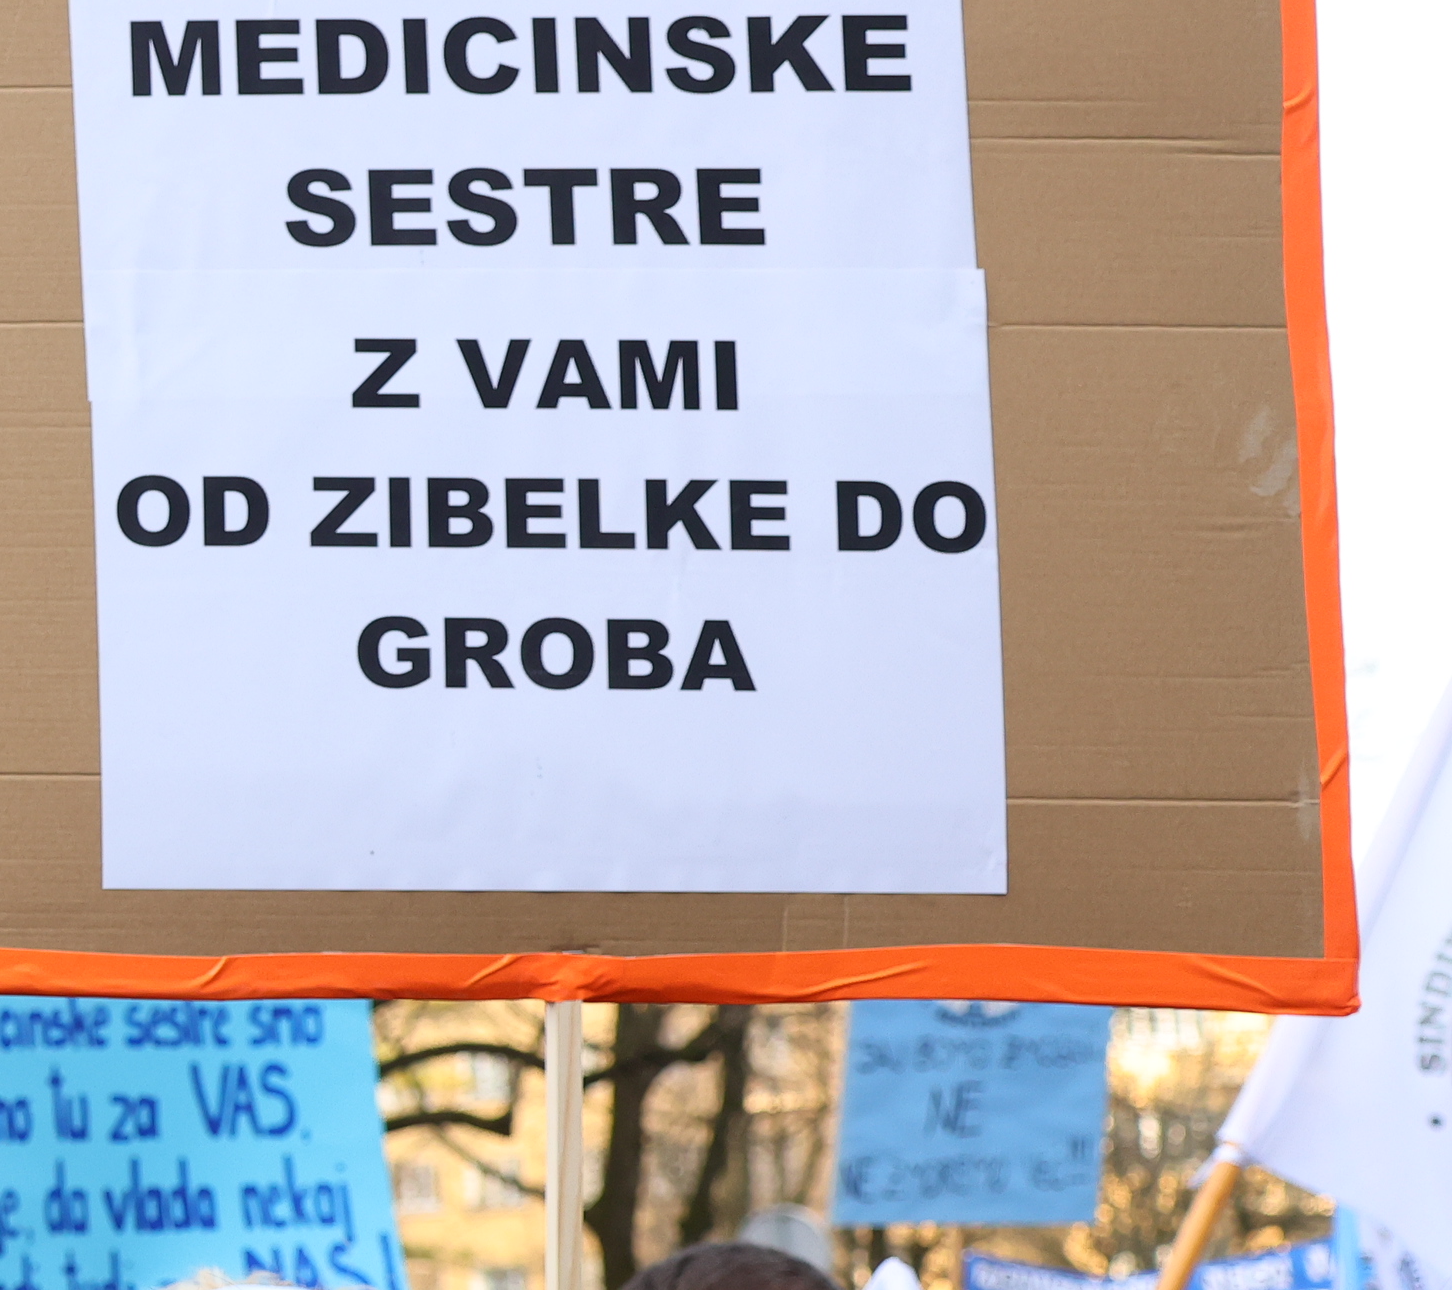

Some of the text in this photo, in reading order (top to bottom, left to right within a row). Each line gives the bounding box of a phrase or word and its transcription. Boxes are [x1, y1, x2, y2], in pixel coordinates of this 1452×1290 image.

[129, 14, 913, 97] MEDICINSKE
[284, 167, 767, 247] SESTRE
[351, 338, 739, 411] Z VAMI
[116, 474, 989, 554] OD ZIBELKE DO
[356, 615, 757, 692] GROBA
